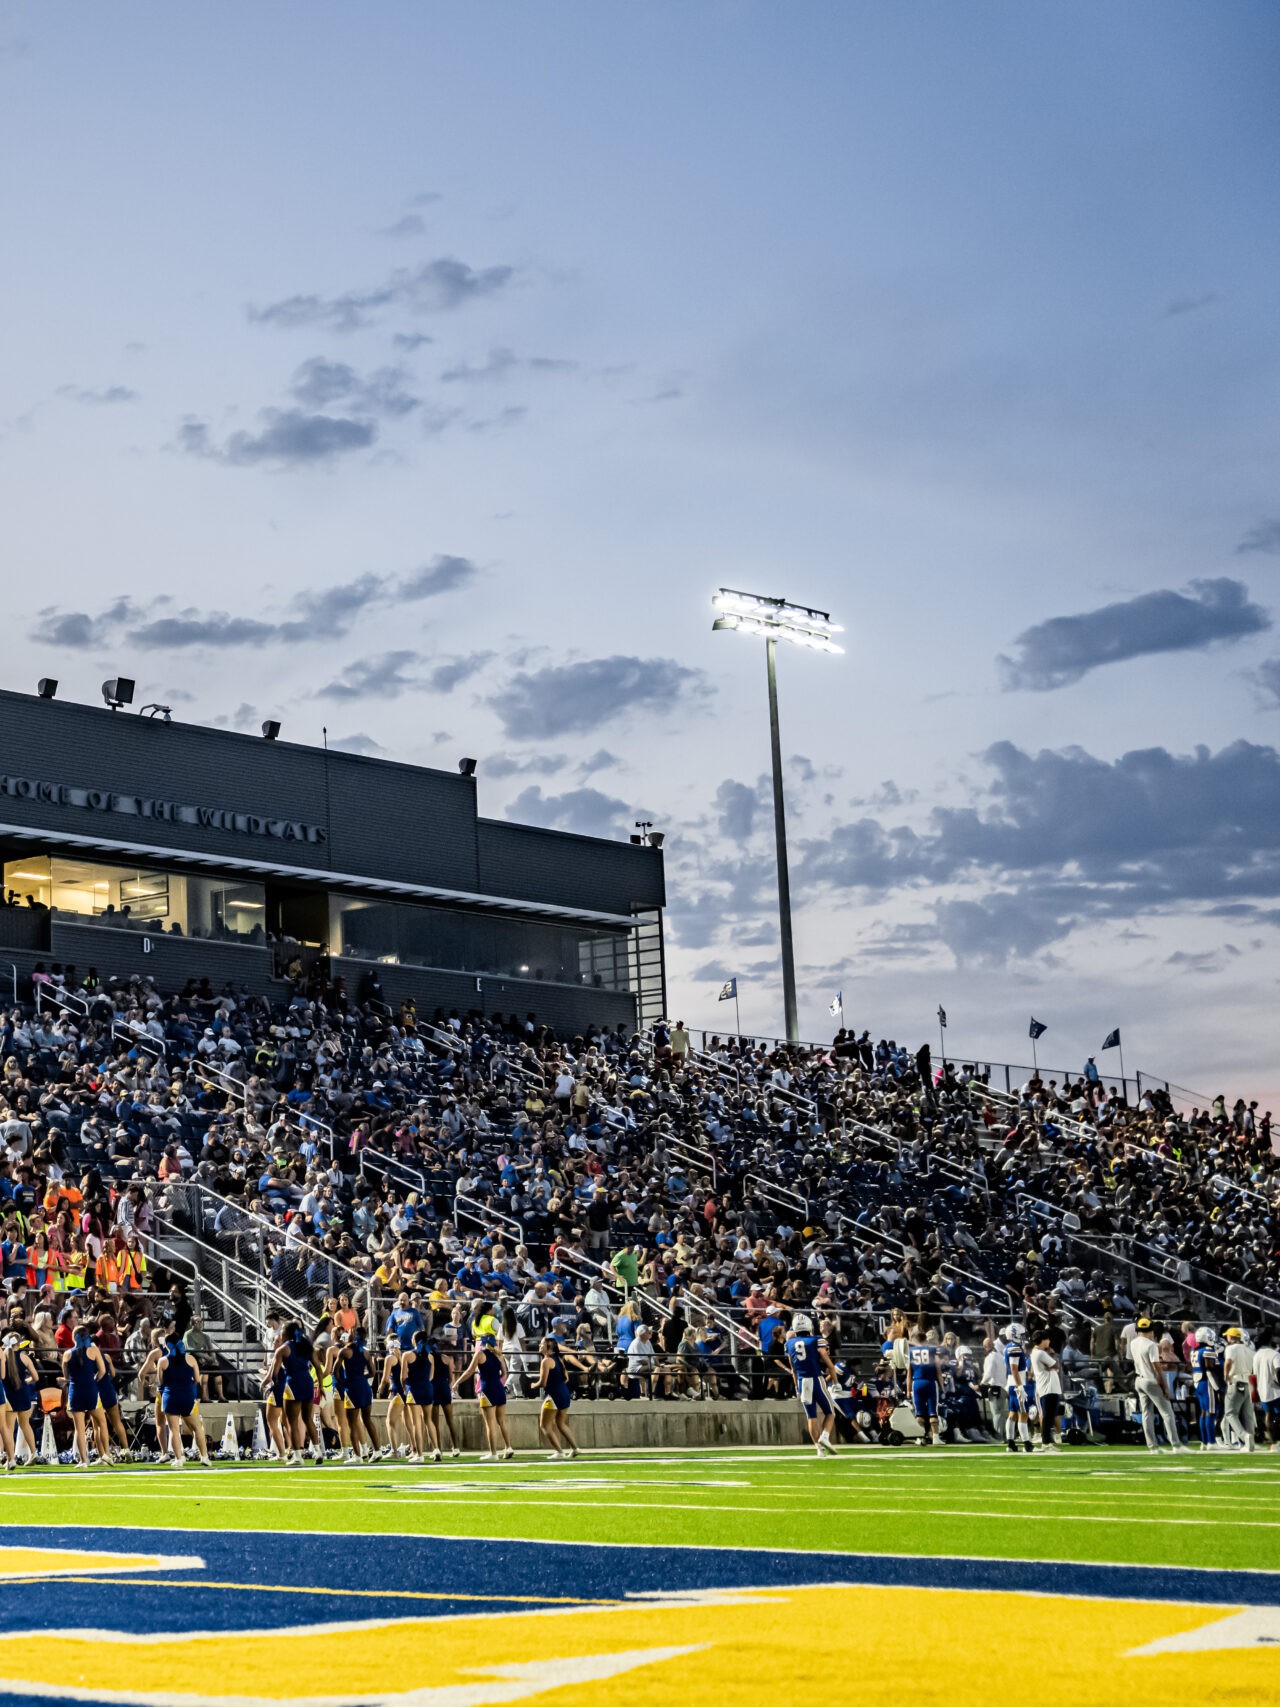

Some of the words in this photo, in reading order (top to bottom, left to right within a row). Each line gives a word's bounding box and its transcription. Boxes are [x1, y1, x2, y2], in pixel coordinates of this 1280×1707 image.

[86, 788, 122, 812] OF
[132, 797, 181, 823] THE
[194, 805, 328, 843] WILDCATS
[143, 937, 150, 953] D
[476, 977, 483, 992] E
[531, 1307, 540, 1329] C
[794, 1340, 807, 1361] 9
[911, 1349, 930, 1365] 58
